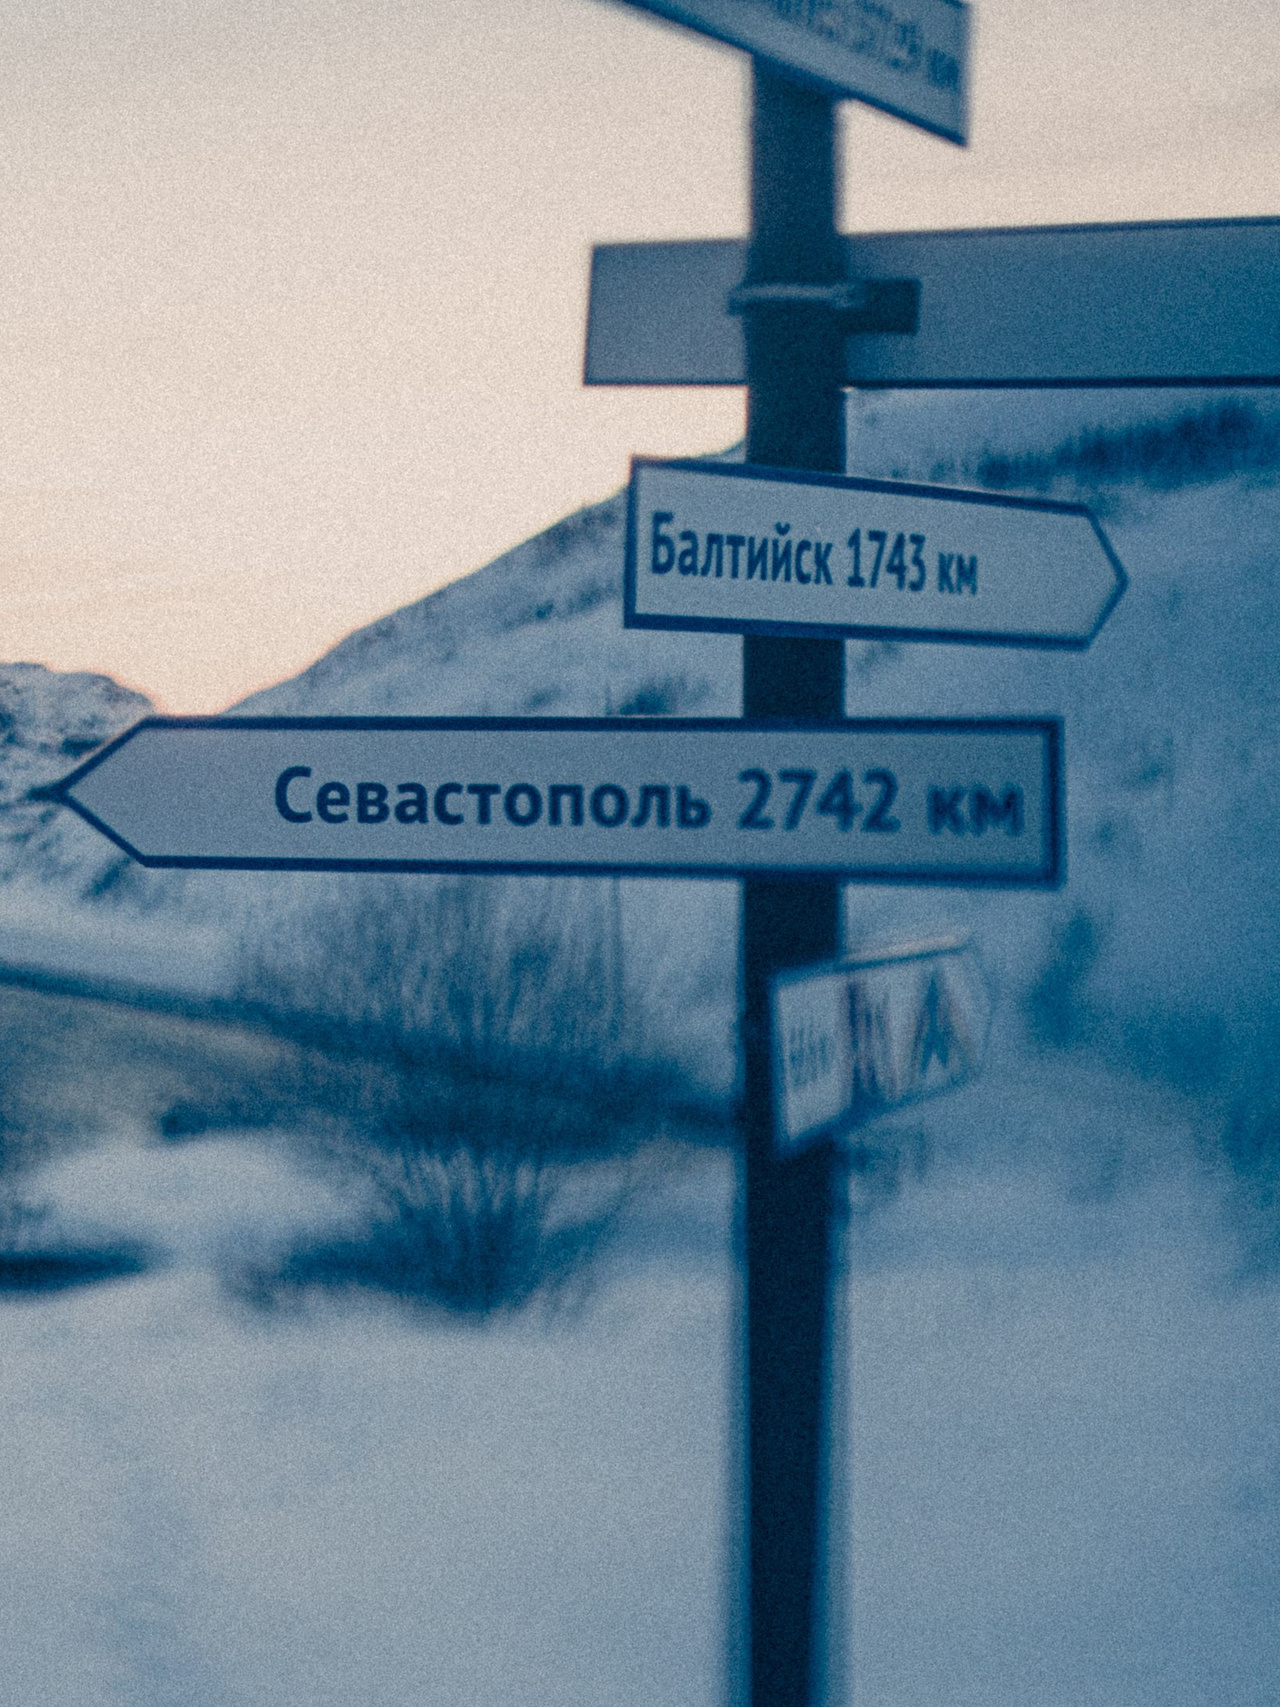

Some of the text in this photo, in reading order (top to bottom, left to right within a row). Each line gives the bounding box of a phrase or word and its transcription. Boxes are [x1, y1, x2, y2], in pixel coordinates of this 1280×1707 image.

[651, 511, 978, 596] Балтийск 1743 км
[273, 765, 1026, 838] Севастополь 2742 км
